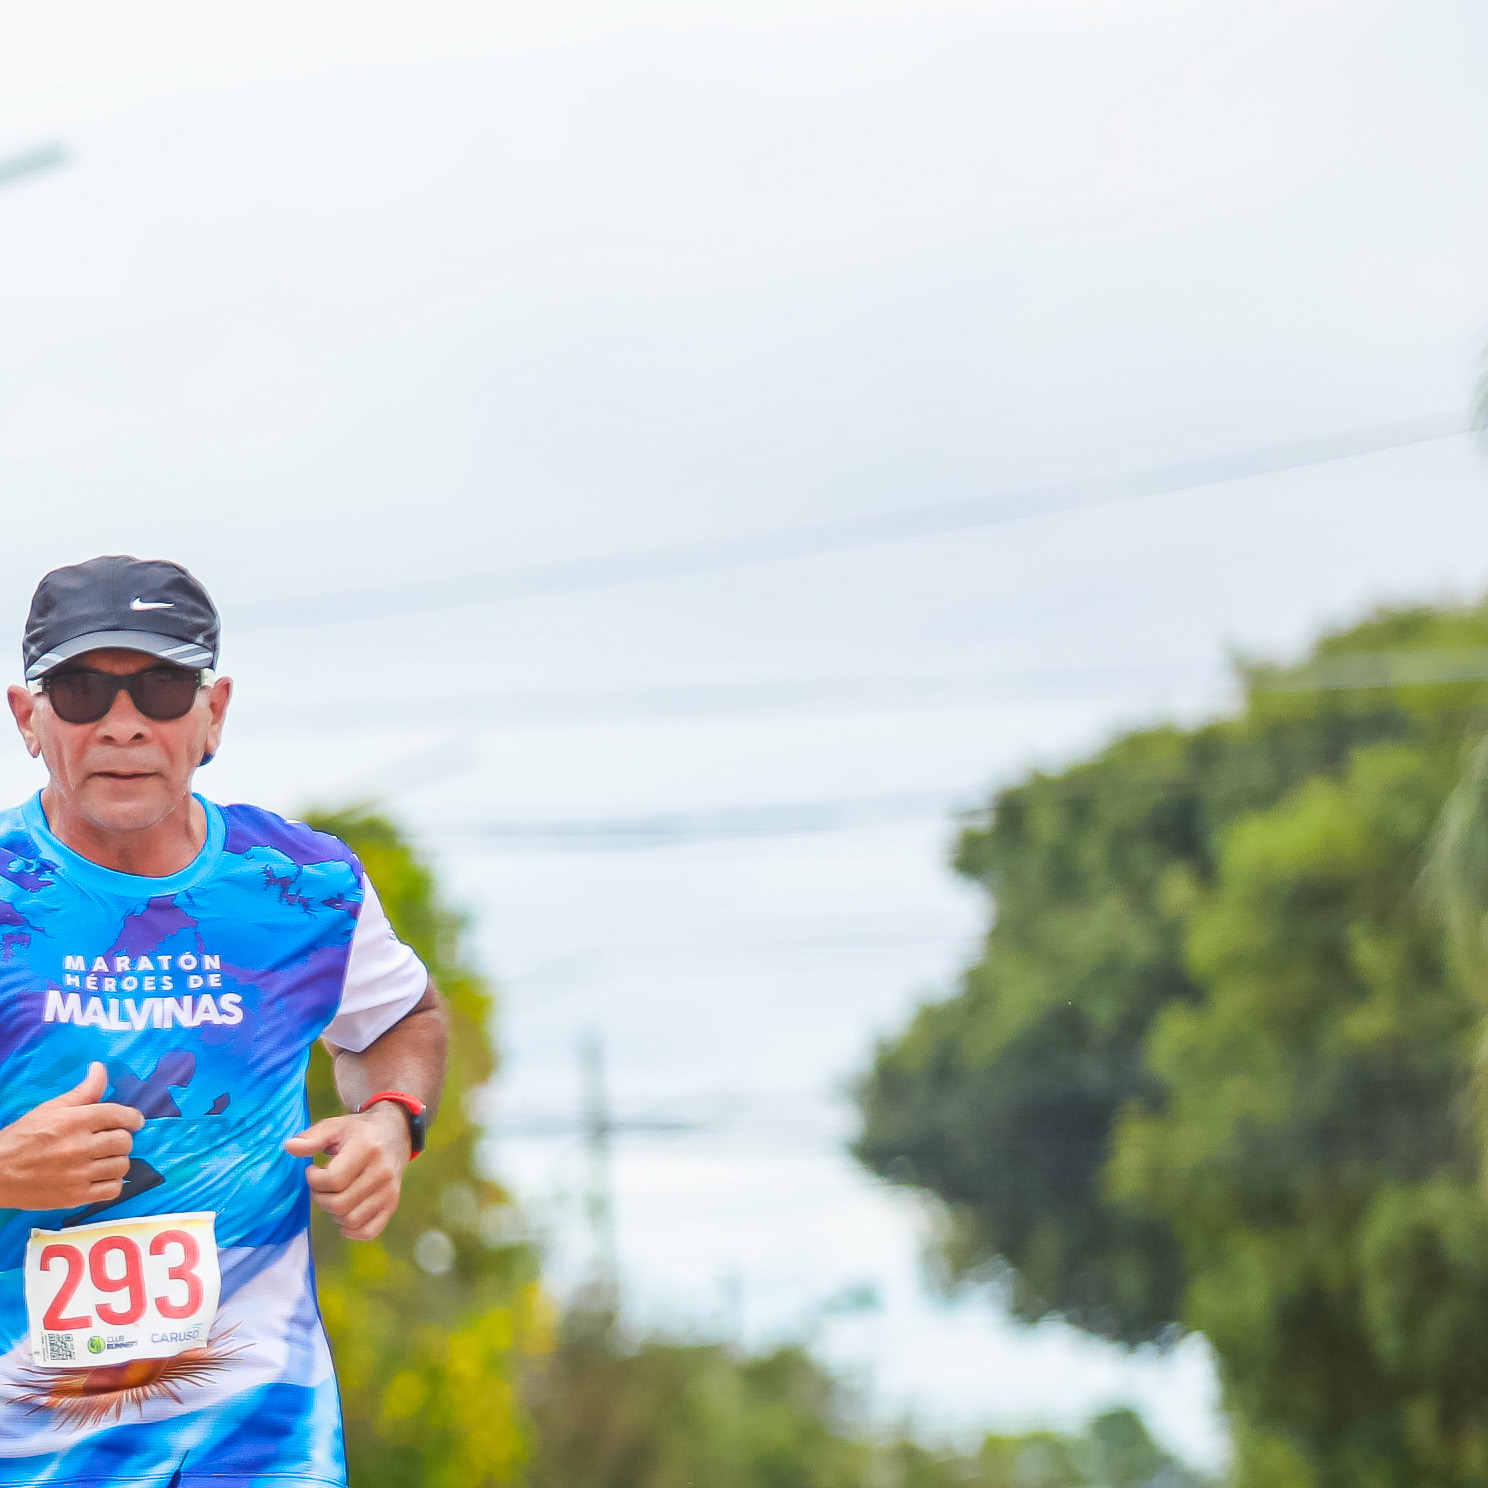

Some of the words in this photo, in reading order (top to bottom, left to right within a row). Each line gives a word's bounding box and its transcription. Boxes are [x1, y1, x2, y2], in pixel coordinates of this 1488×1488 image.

[64, 951, 221, 973] MARATÓN
[64, 974, 174, 992] HÉROES
[188, 973, 222, 989] DE
[44, 989, 244, 1031] MALVINAS
[40, 1229, 204, 1331] 293
[151, 1330, 200, 1343] CARUSO
